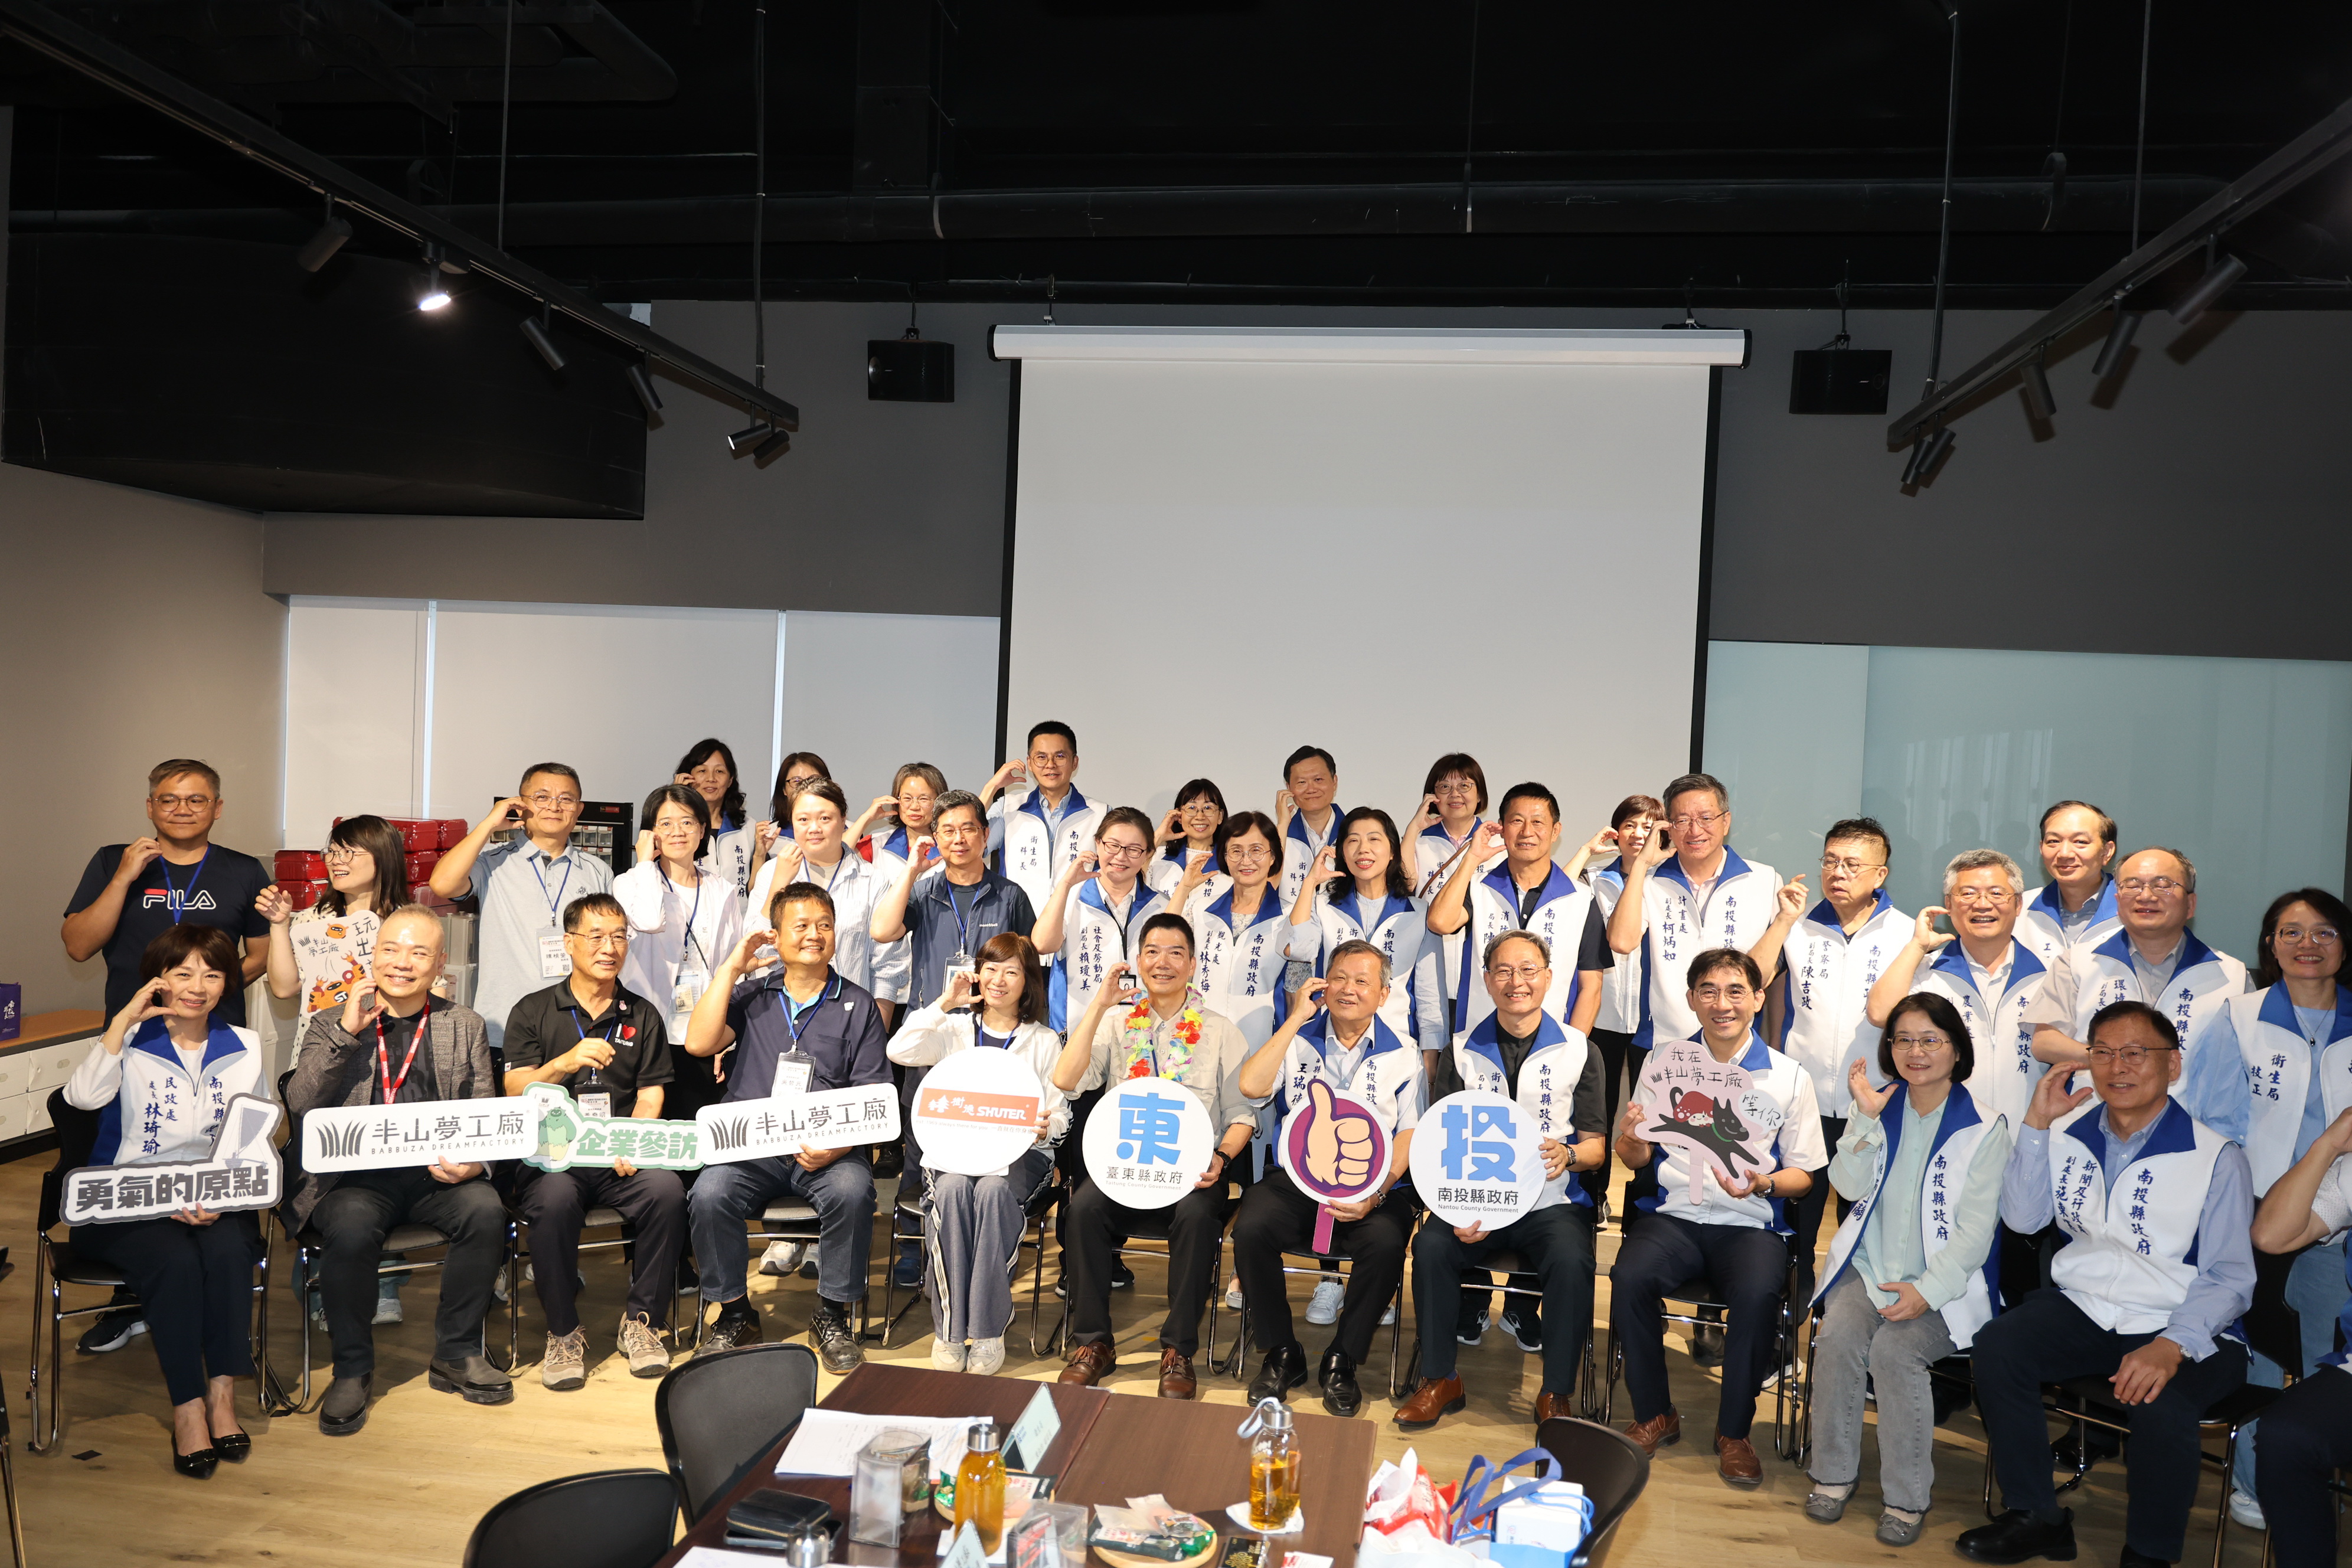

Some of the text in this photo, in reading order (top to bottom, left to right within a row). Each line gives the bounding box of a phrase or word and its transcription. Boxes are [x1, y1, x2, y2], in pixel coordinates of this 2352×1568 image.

[1020, 847, 1028, 870] 科長
[1030, 835, 1038, 867] 衛生局
[1069, 830, 1079, 863] 南投縣
[734, 845, 746, 897] 南投縣政府
[1290, 873, 1297, 896] 科長
[143, 888, 216, 910] FILA
[308, 942, 339, 957] 夢工廠
[313, 937, 328, 947] 半山
[1092, 926, 1103, 984] 社會及勞動局
[1212, 931, 1226, 965] 觀光處
[1245, 933, 1264, 997] 南投縣政府
[1819, 940, 1831, 979] 警察局
[334, 991, 348, 1003] ST
[615, 1023, 622, 1038] I
[615, 1038, 633, 1047] TAITUNG
[1671, 1047, 1701, 1063] 我在
[1366, 1060, 1377, 1105] 南投縣政
[1664, 1066, 1743, 1088] 半山夢工廠
[2251, 1066, 2263, 1096] 技正
[2266, 1053, 2287, 1101] 衛生局
[164, 1077, 179, 1121] 民政處
[951, 1096, 975, 1116] 樹德
[976, 1106, 1027, 1121] SHUTER
[1539, 1064, 1553, 1133] 南投縣政府
[1742, 1095, 1781, 1126] 等你
[372, 1110, 525, 1145] 半山夢工廠
[756, 1097, 887, 1135] 半山夢工廠
[1116, 1092, 1185, 1165] 東
[371, 1138, 525, 1155] BABBUZA DREAMFACTORY
[576, 1128, 698, 1160] 企業參訪
[756, 1122, 888, 1145] BABBUZA DREAMFACTORY
[1441, 1105, 1517, 1182] 投
[76, 1166, 269, 1213] 勇氣的原點
[1106, 1166, 1183, 1184] 臺東縣政府
[1438, 1187, 1519, 1206] 南投縣政府
[1931, 1154, 1949, 1241] 南投縣政府
[2128, 1168, 2152, 1255] 南投縣政府
